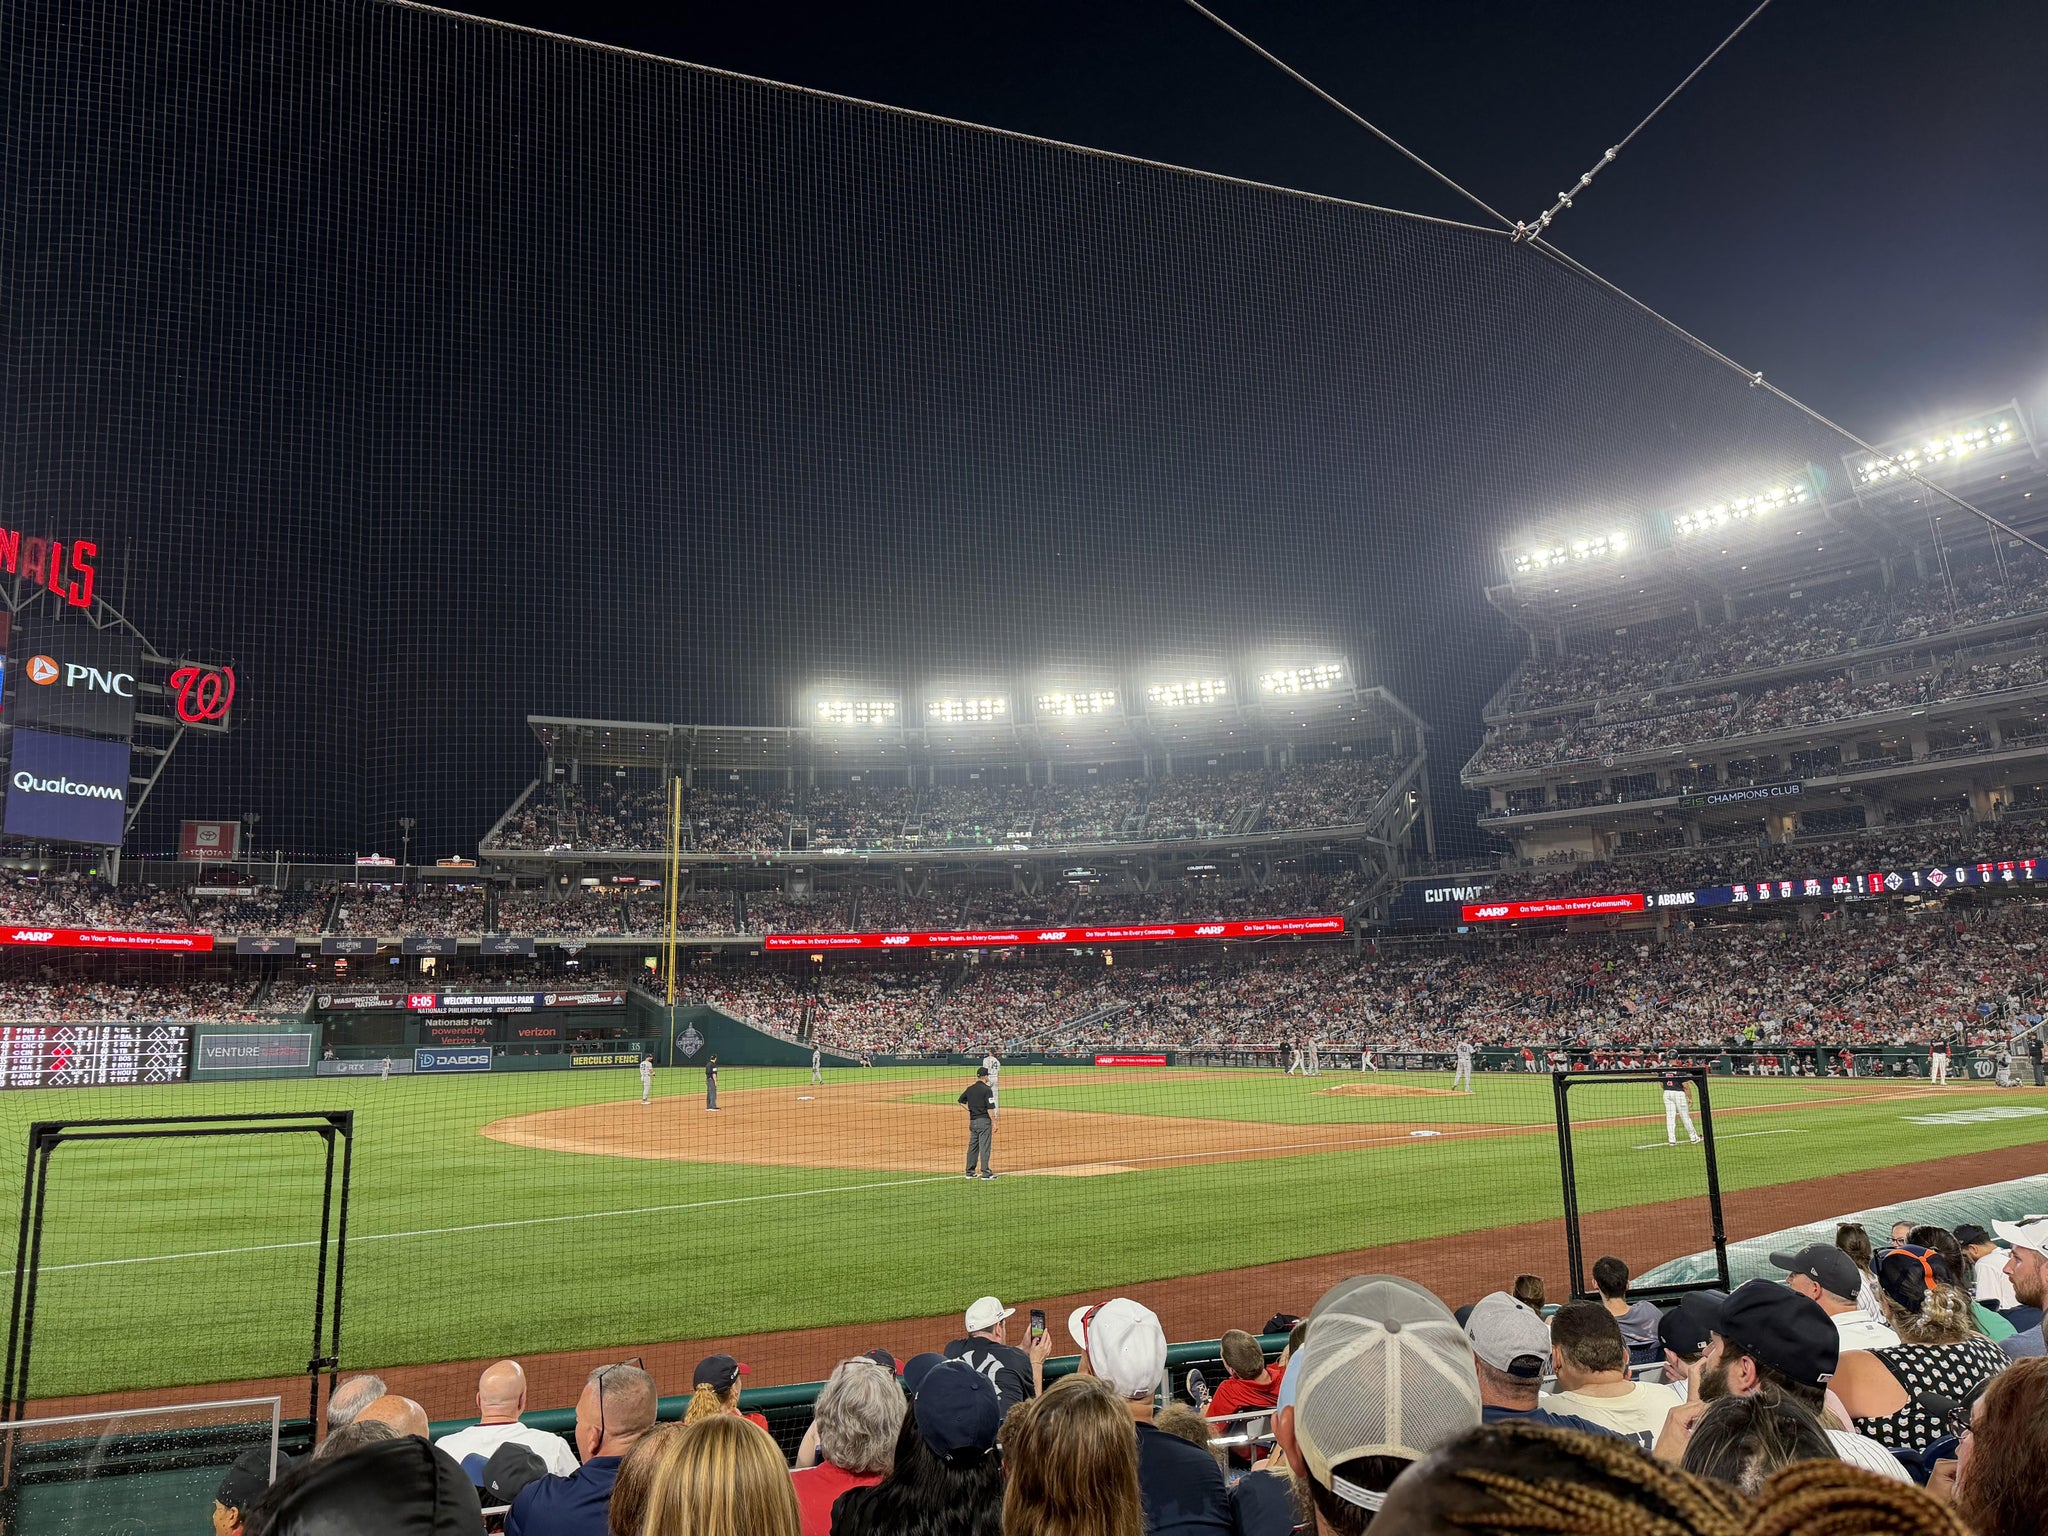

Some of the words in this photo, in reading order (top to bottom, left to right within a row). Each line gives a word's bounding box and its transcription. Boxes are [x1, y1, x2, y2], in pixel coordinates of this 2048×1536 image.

[65, 663, 135, 697] PNC
[13, 771, 123, 801] Qualcomm
[1707, 787, 1769, 804] CHAMPIONS
[1771, 785, 1800, 796] CLUB
[2026, 868, 2033, 879] 2
[1781, 888, 1791, 897] 67
[1804, 885, 1821, 896] .872
[1832, 883, 1851, 893] 99.2
[1425, 886, 1493, 903] CUTWAT
[1732, 891, 1748, 902] .276
[1759, 889, 1769, 899] 20
[1647, 896, 1653, 907] 5
[1658, 892, 1695, 906] ABRAMS
[1475, 906, 1508, 918] AARP
[1530, 905, 1544, 913] Your
[1573, 903, 1592, 911] Every
[1194, 926, 1225, 935] AARP
[1289, 923, 1304, 931] Every
[12, 930, 54, 942] AARP
[972, 934, 987, 942] Every
[1037, 931, 1067, 941] AARP
[1129, 929, 1144, 937] Every
[91, 934, 106, 942] Your
[107, 935, 127, 943] Team.
[136, 937, 154, 945] Every
[814, 937, 829, 945] Every
[880, 936, 909, 945] AARP
[334, 995, 379, 1005] WASHINGTON
[411, 996, 432, 1006] 9:05
[443, 996, 474, 1005] WELCOME
[474, 996, 482, 1004] TO
[483, 996, 517, 1005] NATIONALS
[518, 995, 535, 1004] PARK
[558, 993, 599, 1002] WASHINGTON
[577, 996, 611, 1005] NATIONALS
[355, 1000, 393, 1008] NATIONALS
[425, 1018, 469, 1027] Nationals
[471, 1018, 493, 1026] Park
[431, 1026, 473, 1036] powered
[474, 1026, 486, 1035] by
[518, 1027, 556, 1037] verizon
[631, 1042, 641, 1050] 335
[207, 1047, 260, 1057] VENTURE
[437, 1055, 488, 1065] DABOS
[573, 1055, 613, 1065] HERCULES
[614, 1054, 639, 1064] FENCE
[348, 1063, 365, 1071] RTX
